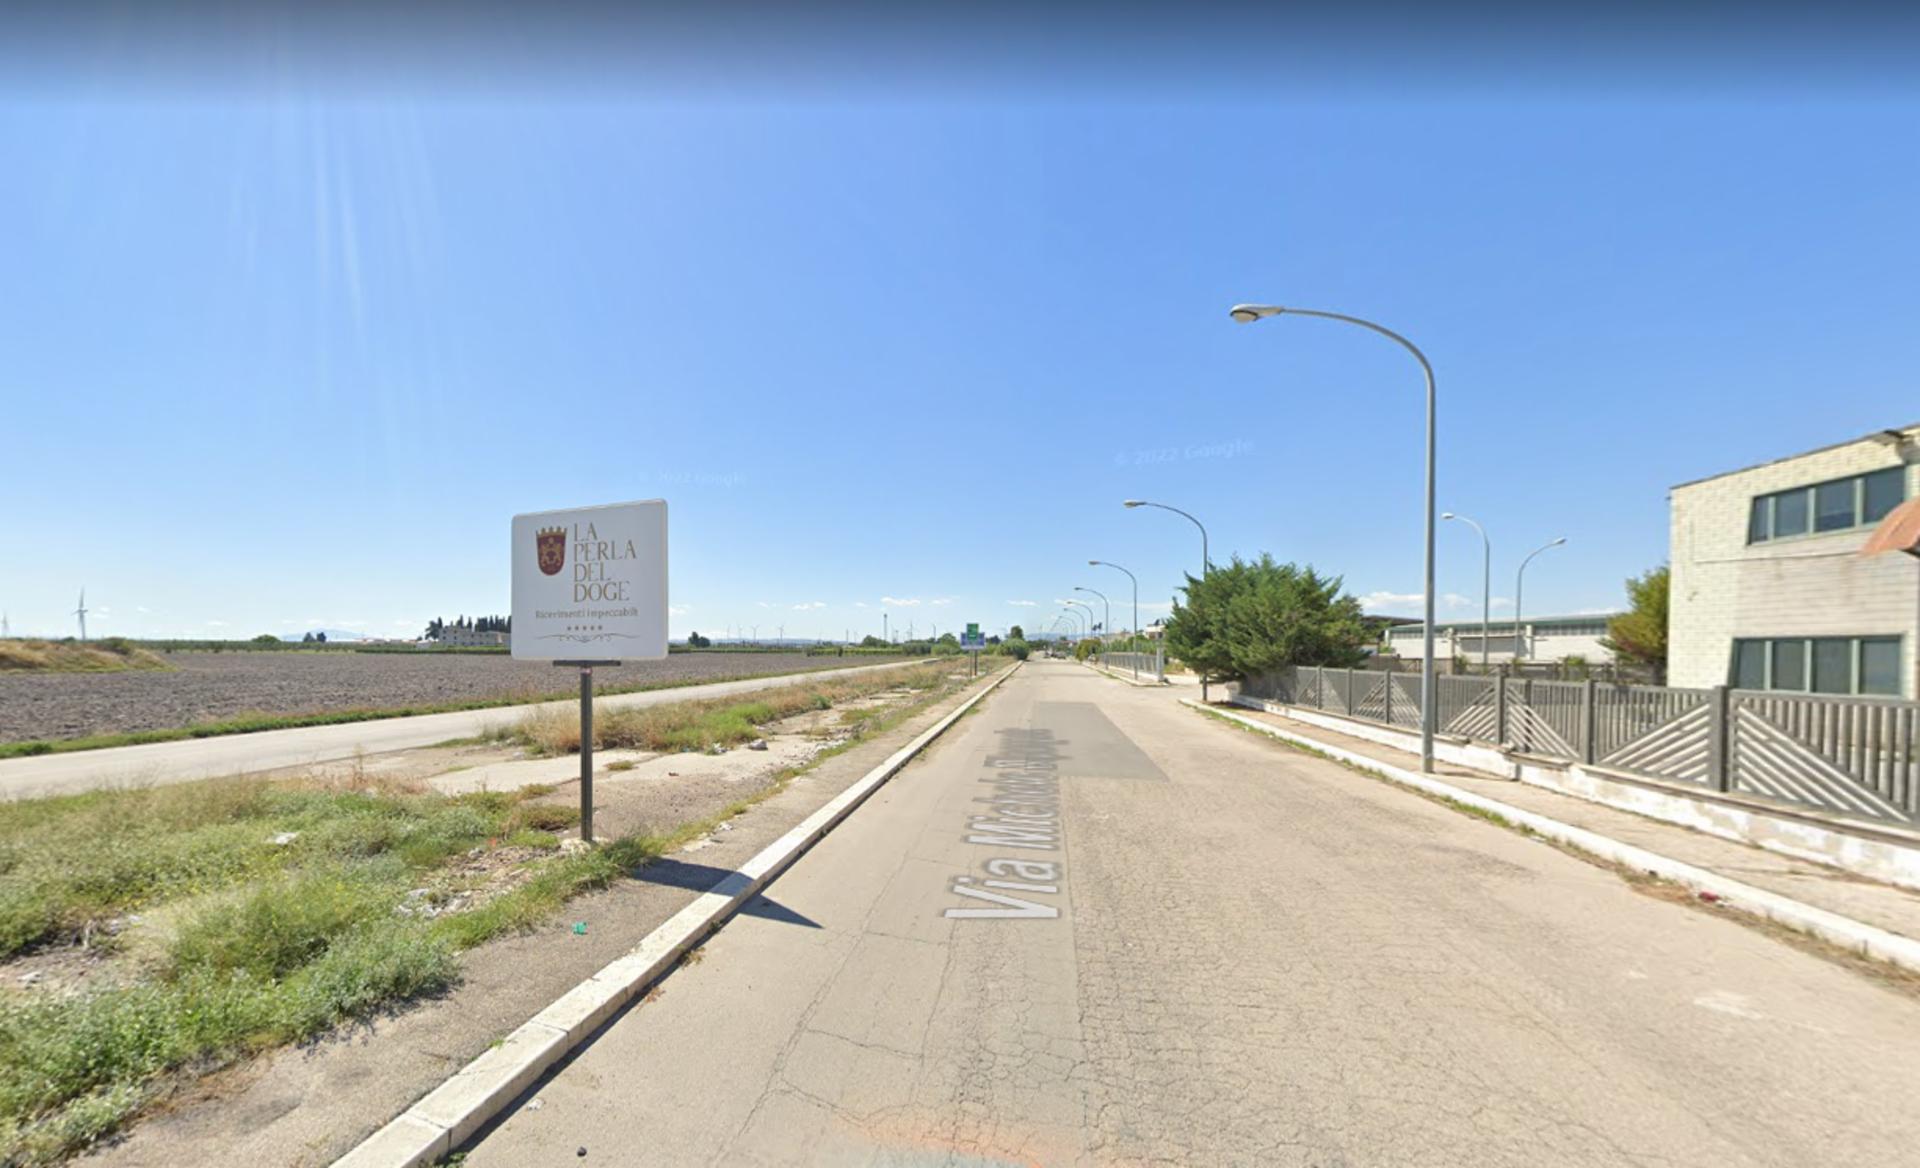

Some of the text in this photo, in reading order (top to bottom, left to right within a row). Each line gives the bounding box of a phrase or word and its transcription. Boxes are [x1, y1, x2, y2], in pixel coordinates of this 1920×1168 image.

[573, 522, 597, 541] LA
[573, 540, 637, 562] PERLA
[573, 562, 611, 583] DEL
[573, 581, 630, 603] DOGE
